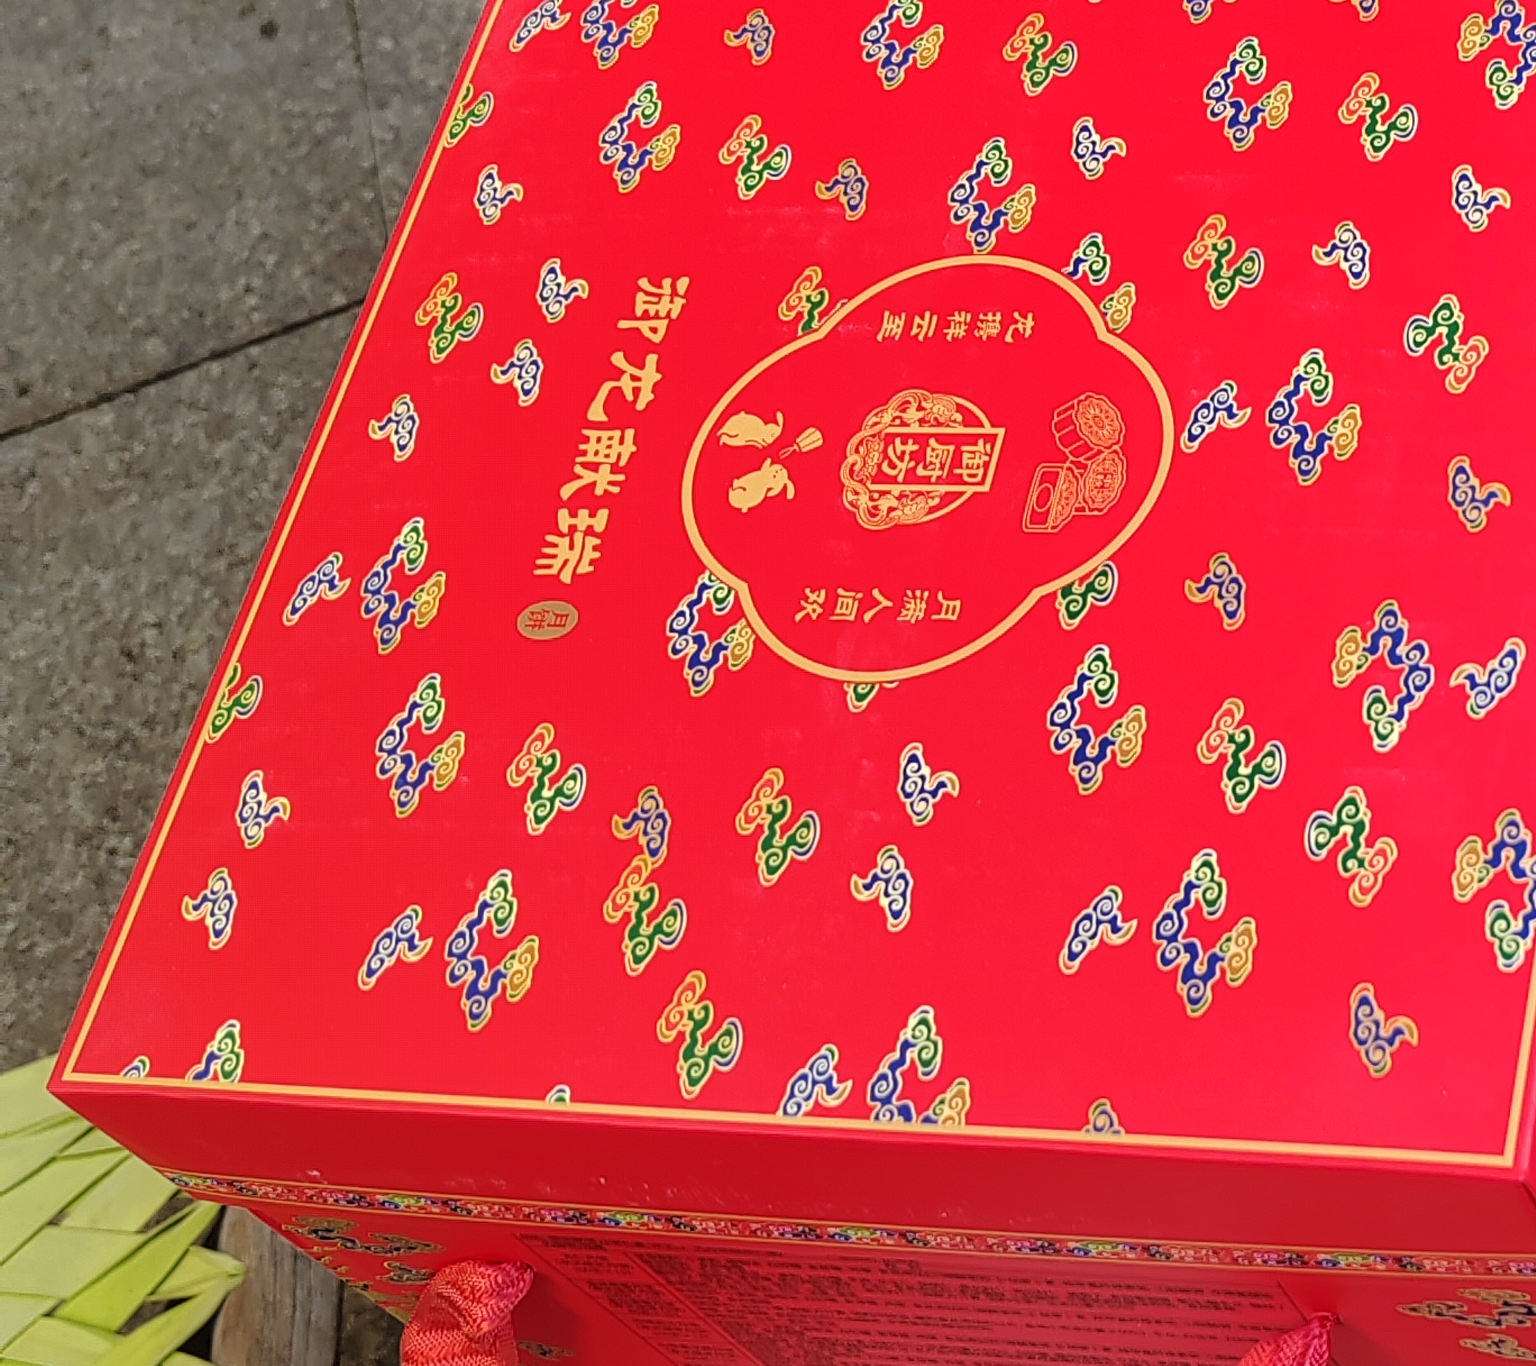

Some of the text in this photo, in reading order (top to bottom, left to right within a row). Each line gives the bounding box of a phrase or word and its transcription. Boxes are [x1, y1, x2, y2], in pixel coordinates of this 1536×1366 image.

[876, 310, 1036, 343] 龙携祥云至
[532, 274, 692, 585] 御龙献瑞
[880, 439, 990, 483] 御厨坊
[525, 609, 571, 631] 月饼
[793, 587, 962, 624] 月满人间欢
